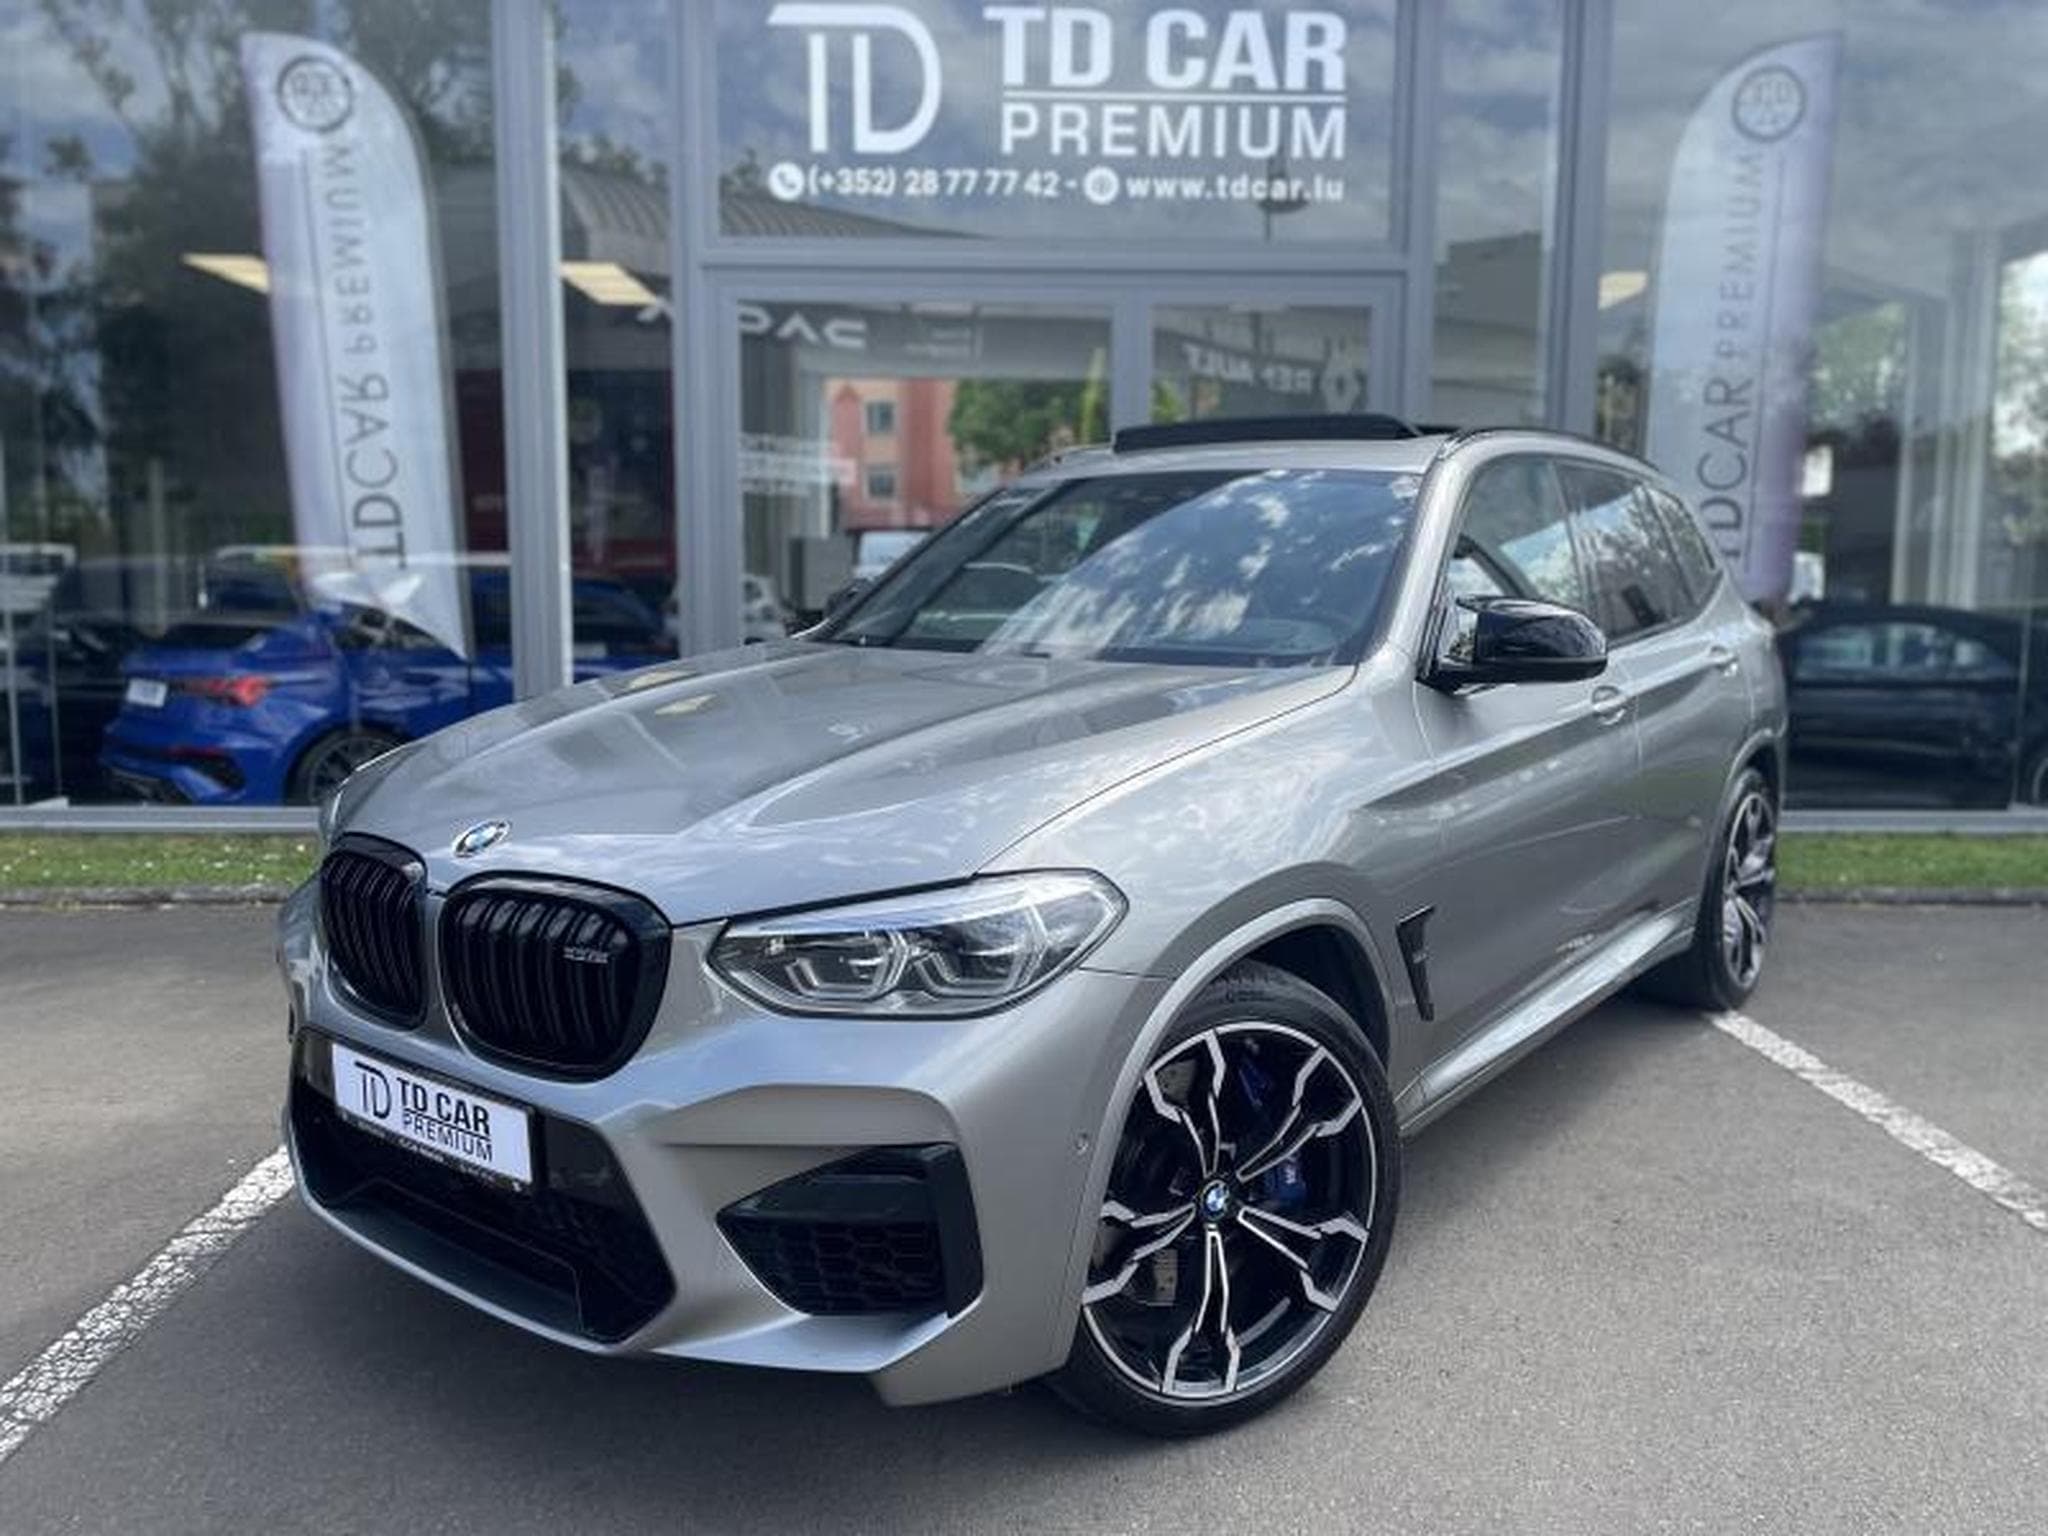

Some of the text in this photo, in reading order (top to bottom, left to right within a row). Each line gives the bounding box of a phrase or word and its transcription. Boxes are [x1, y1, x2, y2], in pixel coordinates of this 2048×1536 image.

[983, 6, 1347, 91] TD CAR
[1001, 102, 1346, 160] PREMIUM
[808, 165, 1061, 198] (+352) 28 77 77 42
[1126, 170, 1345, 202] www.tdcar.lu
[1715, 148, 1764, 361] PREMIUM
[354, 1060, 392, 1120] TD
[396, 1077, 429, 1113] TD
[436, 1091, 491, 1137] CAR
[402, 1111, 494, 1164] PREMIUM
